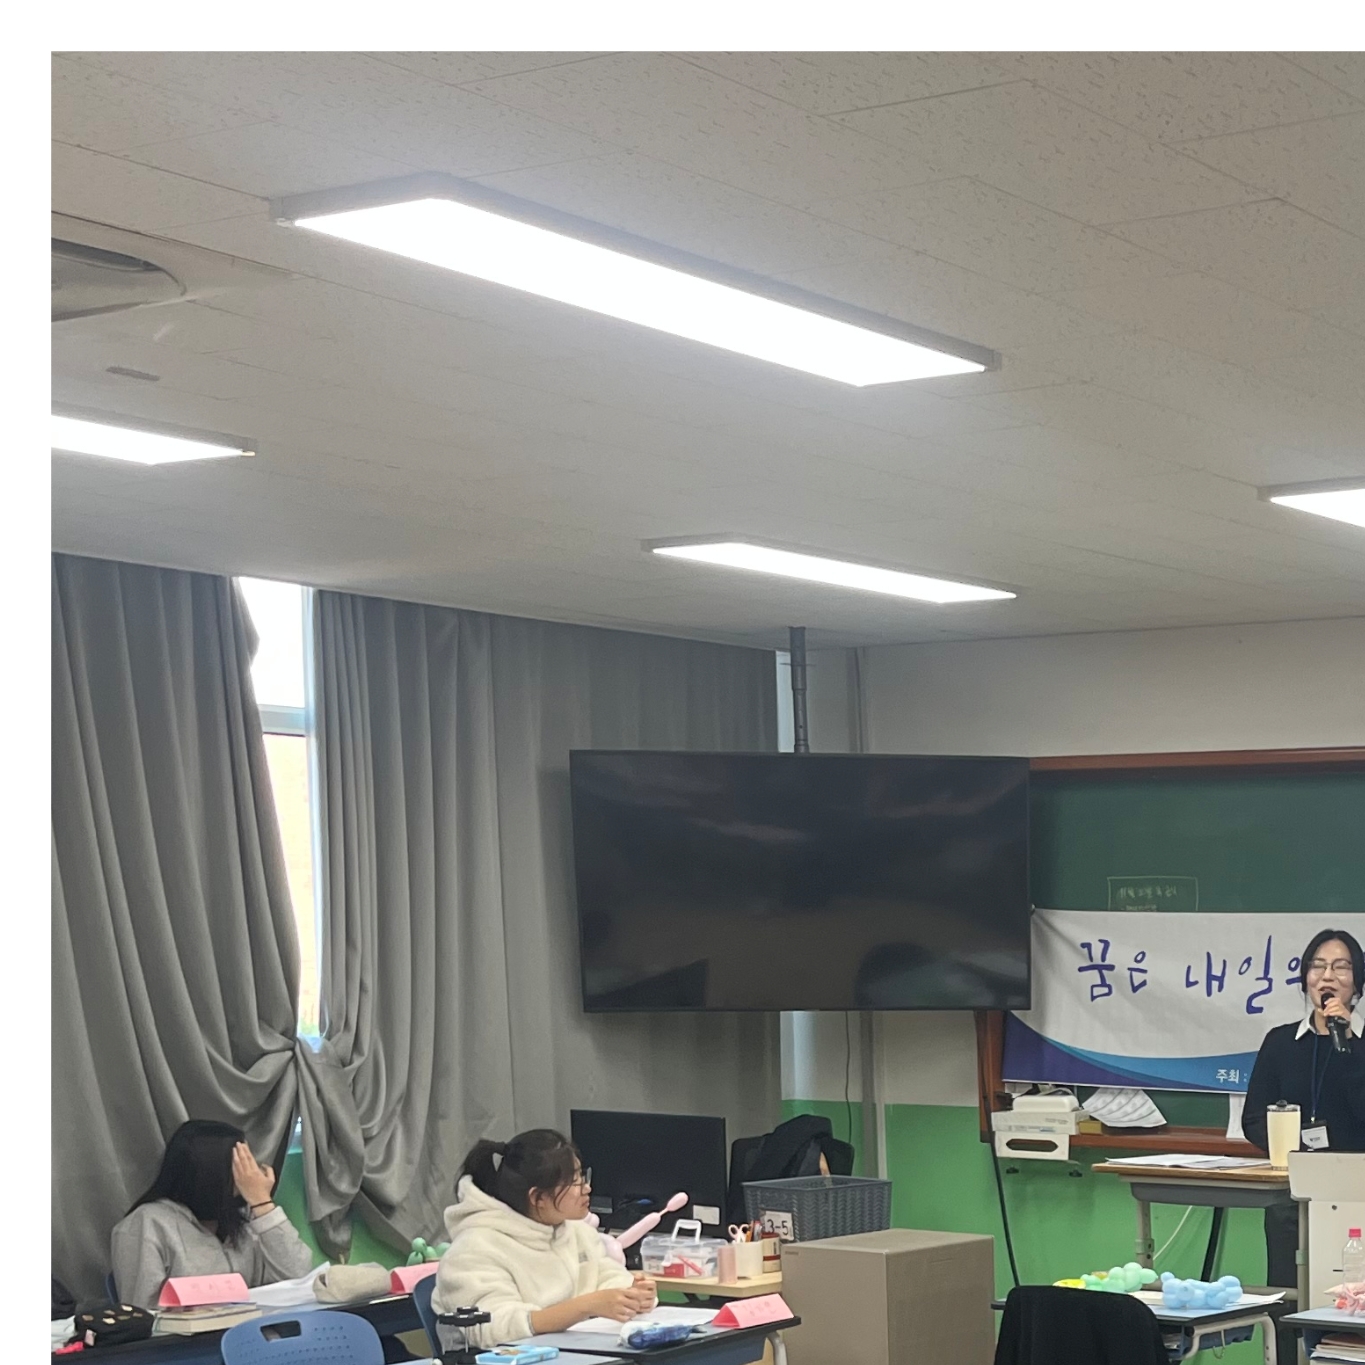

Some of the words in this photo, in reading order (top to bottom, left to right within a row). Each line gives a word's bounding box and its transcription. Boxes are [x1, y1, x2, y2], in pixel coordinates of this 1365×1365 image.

[1078, 938, 1149, 1001] 꿈은
[1215, 1069, 1239, 1082] 주최
[767, 1219, 789, 1235] 3-5
